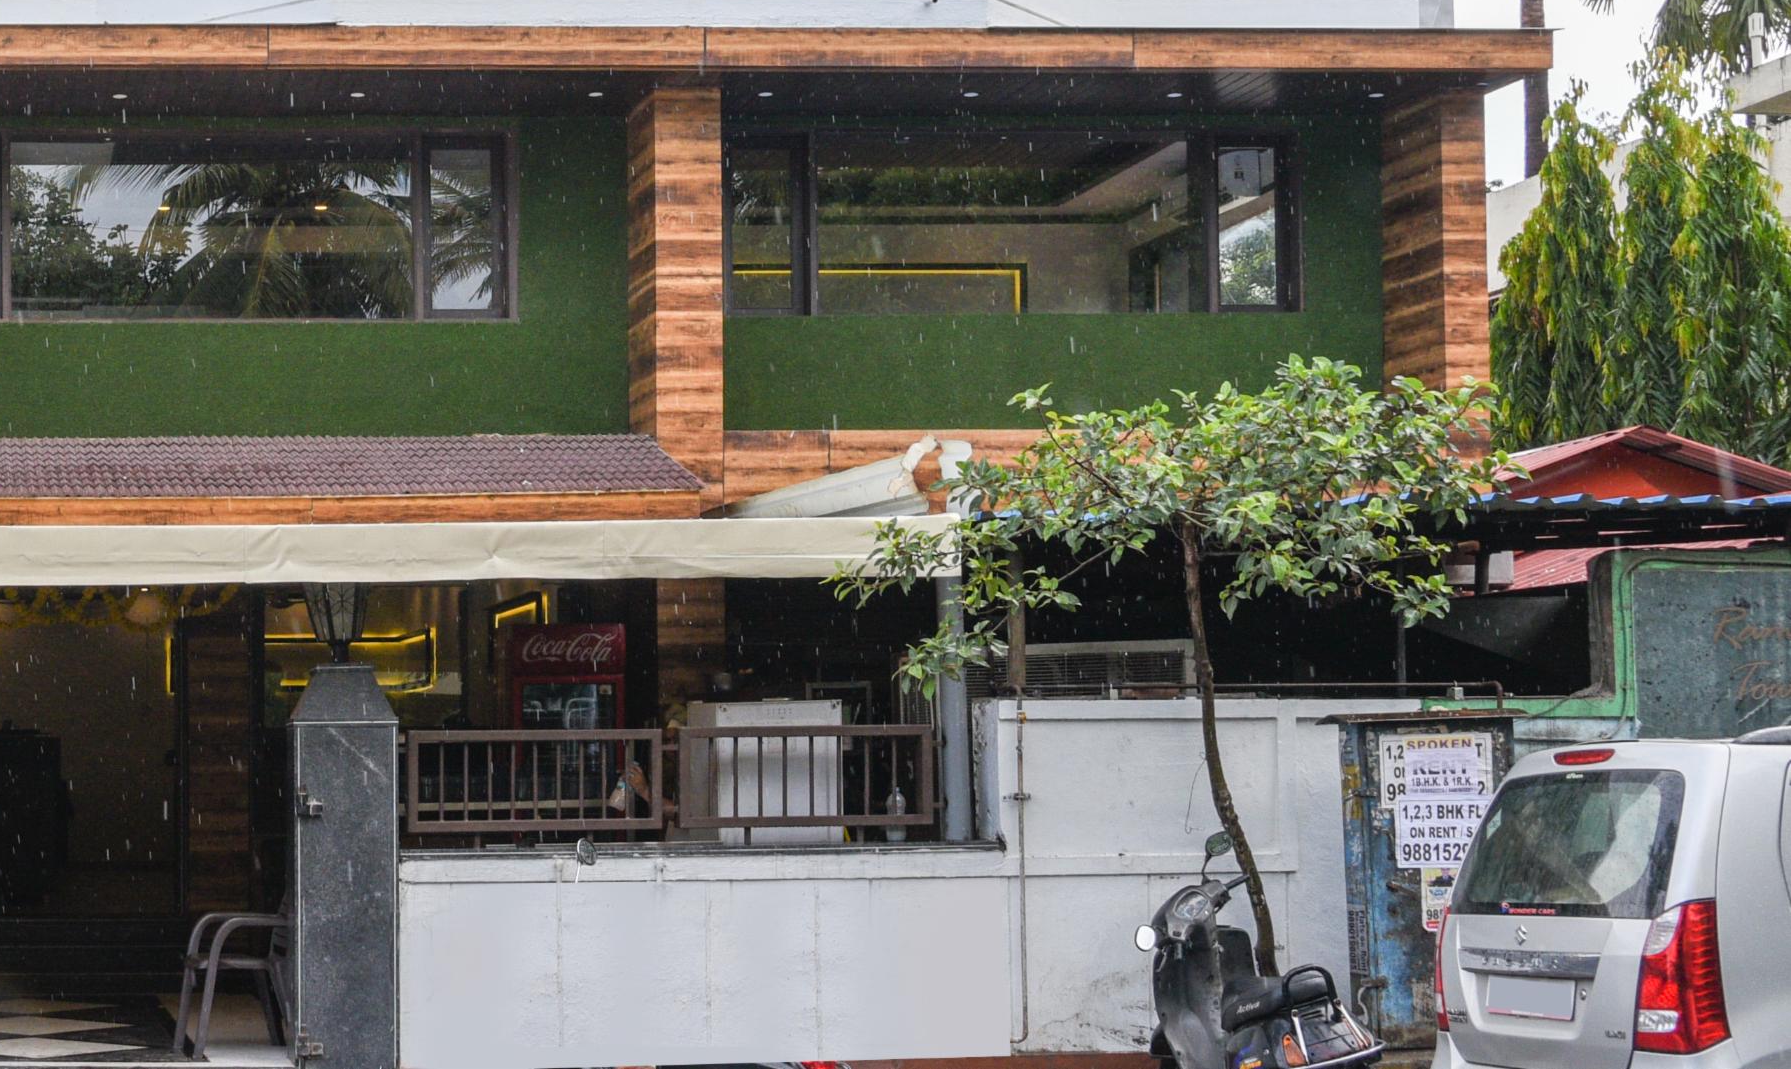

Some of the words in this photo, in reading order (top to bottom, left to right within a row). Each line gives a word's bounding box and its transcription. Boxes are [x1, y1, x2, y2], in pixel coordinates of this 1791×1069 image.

[522, 633, 618, 662] Coca-Cola
[1406, 738, 1472, 750] SPOKEN
[1402, 804, 1433, 823] 1,2,3
[1436, 804, 1465, 820] BHK
[1468, 804, 1488, 820] FL
[1410, 826, 1426, 839] ON
[1428, 826, 1458, 839] RENT
[1466, 826, 1478, 838] S
